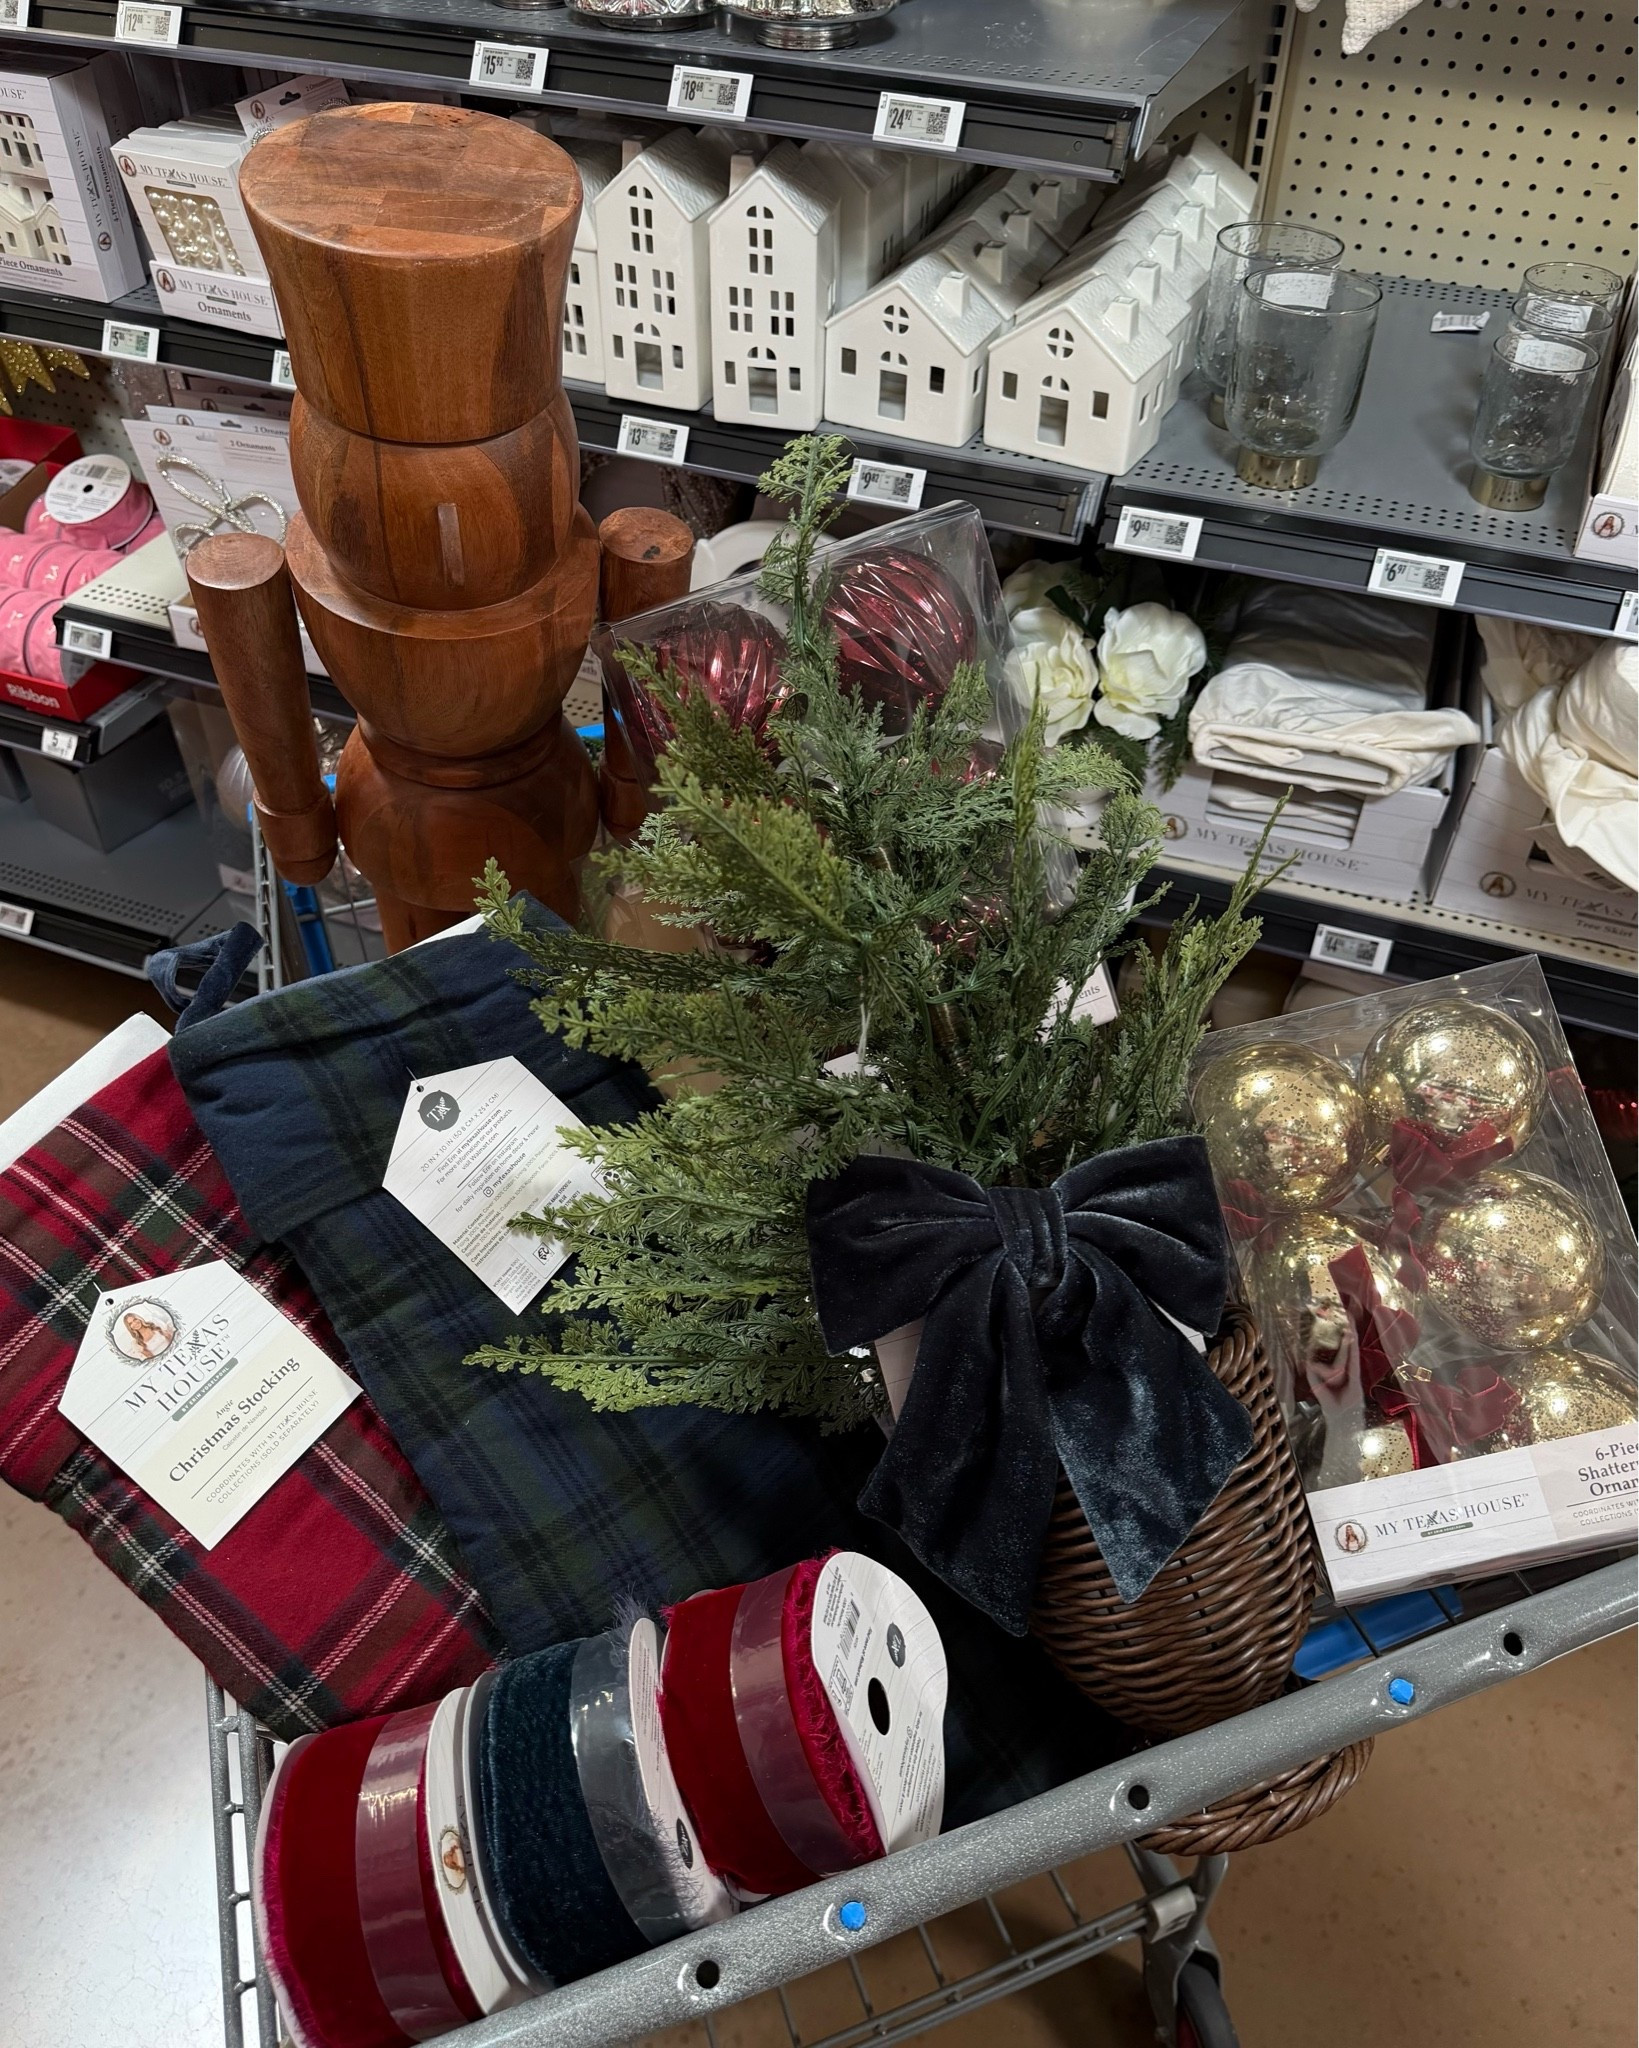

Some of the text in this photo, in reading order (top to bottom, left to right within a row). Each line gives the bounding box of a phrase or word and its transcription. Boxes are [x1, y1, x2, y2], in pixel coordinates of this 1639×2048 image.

[95, 145, 111, 192] Ornaments
[140, 164, 154, 174] MY
[155, 166, 188, 181] TEXAS
[19, 260, 63, 276] Ornaments
[179, 279, 195, 290] MY
[197, 281, 230, 296] TEXAS
[197, 302, 252, 322] Ornaments
[1196, 828, 1222, 841] MY
[1226, 834, 1286, 854] TEXAS
[1560, 894, 1624, 918] TEXAS
[437, 1162, 449, 1173] Find
[447, 1154, 458, 1163] Erin
[461, 1106, 502, 1149] mytexashouse.com
[462, 1133, 499, 1170] visit Walmart.com
[436, 1176, 445, 1185] For
[445, 1165, 457, 1177] more
[455, 1140, 481, 1166] information
[467, 1171, 484, 1189] Follow
[482, 1162, 492, 1174] Erin
[495, 1135, 518, 1159] Instagram
[492, 1153, 525, 1188] mytexashouse
[455, 1205, 463, 1213] for
[463, 1194, 475, 1206] daily
[473, 1172, 495, 1195] inspiration
[499, 1154, 513, 1167] home
[452, 1228, 469, 1245] Material
[471, 1253, 480, 1263] Care
[123, 1314, 229, 1414] MY TEXAS
[181, 1367, 229, 1412] BY ERIN VOGELPOHL
[169, 1358, 300, 1481] Christmas Stocking
[216, 1400, 233, 1419] Angie
[247, 1405, 267, 1425] Navidad
[206, 1390, 318, 1503] COORDINATES WITH MY TEXAS HOUSE
[218, 1400, 319, 1504] COLLECTIONS (SOLD SEPARATELY)
[1374, 1520, 1399, 1538] MY
[1403, 1508, 1459, 1530] TEXAS
[1573, 1502, 1625, 1518] COORDINATES
[1580, 1510, 1632, 1526] COLLECTIONS
